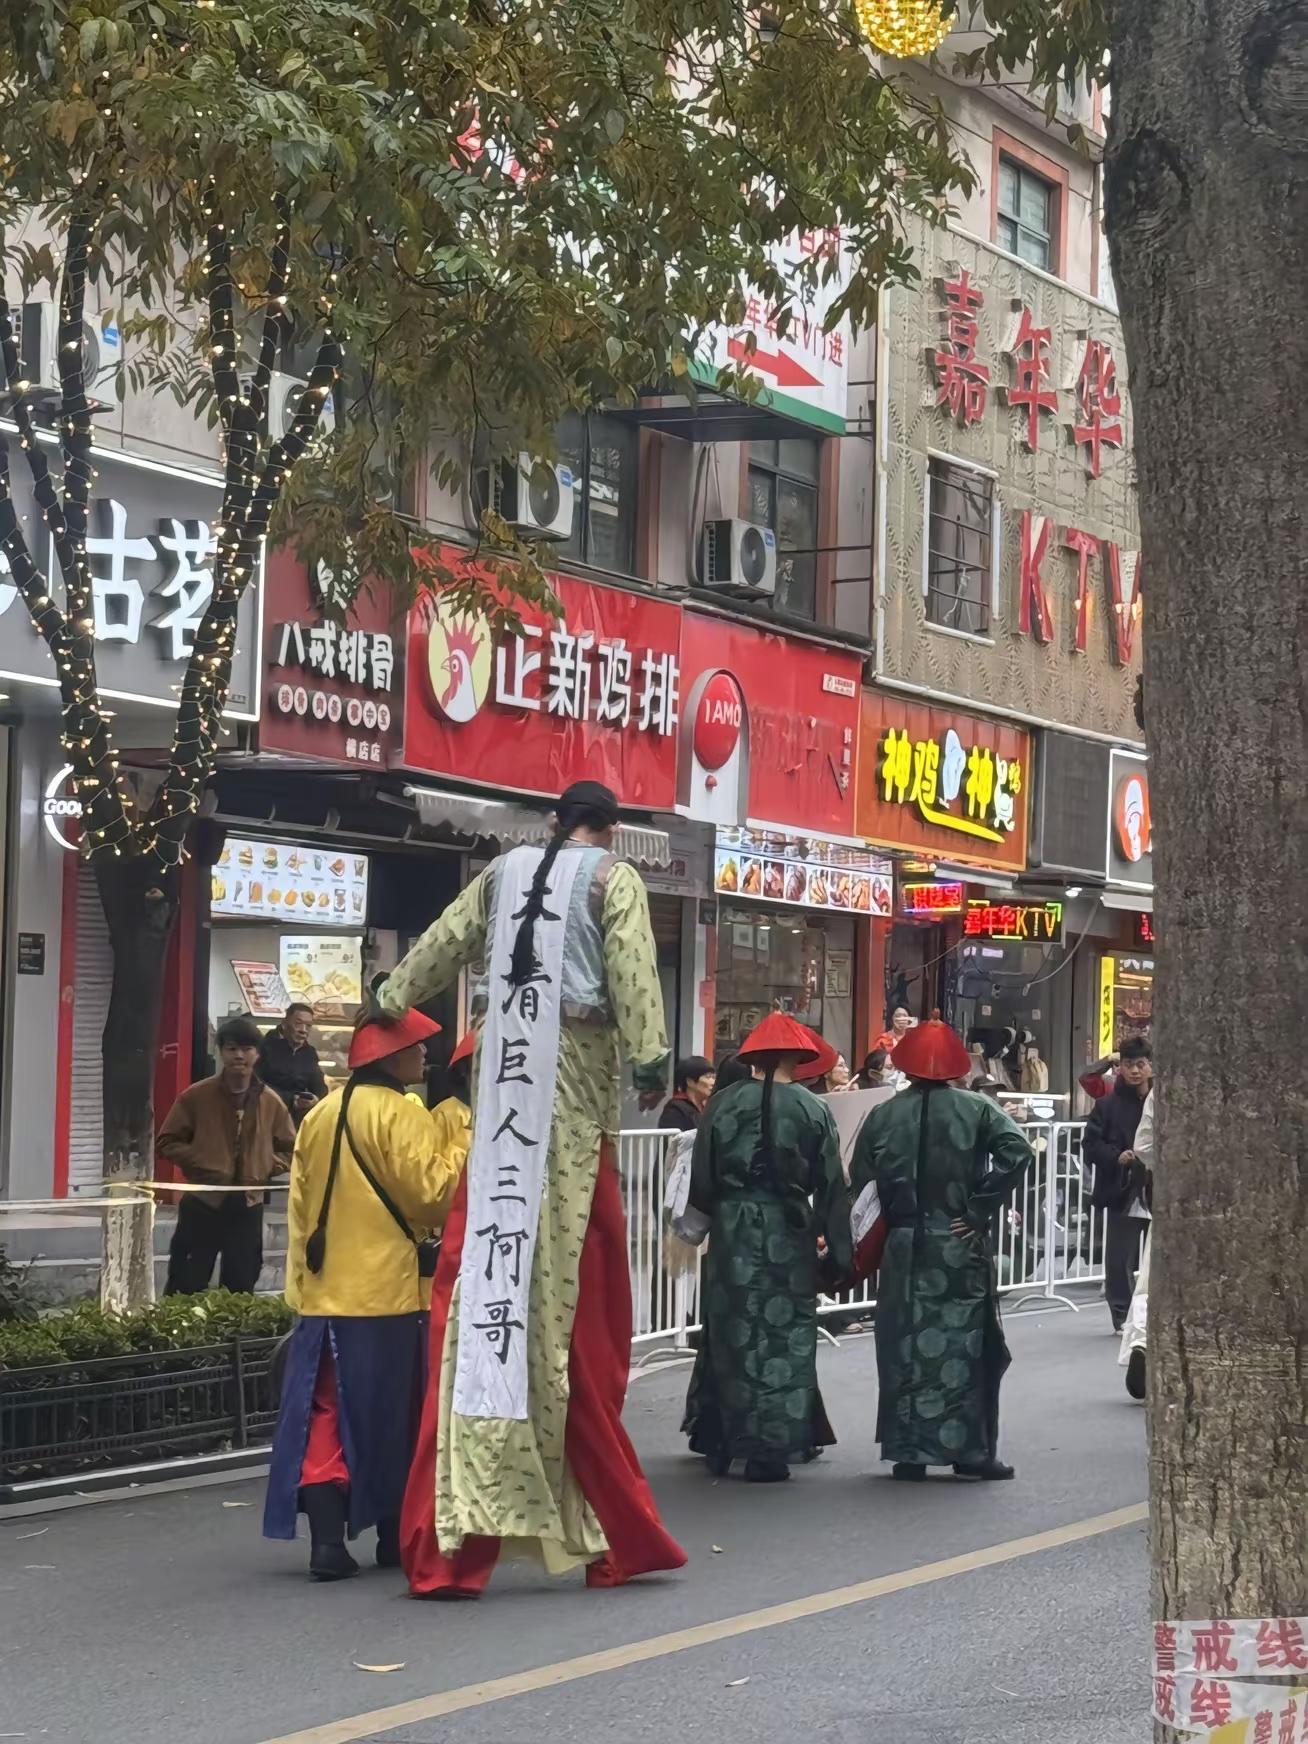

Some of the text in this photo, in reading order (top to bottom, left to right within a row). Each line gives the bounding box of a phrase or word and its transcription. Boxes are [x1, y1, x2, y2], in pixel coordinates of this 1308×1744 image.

[934, 264, 1123, 480] 嘉年华
[1018, 508, 1143, 665] KTV
[278, 619, 394, 692] 八戒排骨
[495, 618, 681, 736] 正新鸡排
[1154, 1619, 1308, 1672] 警戒线
